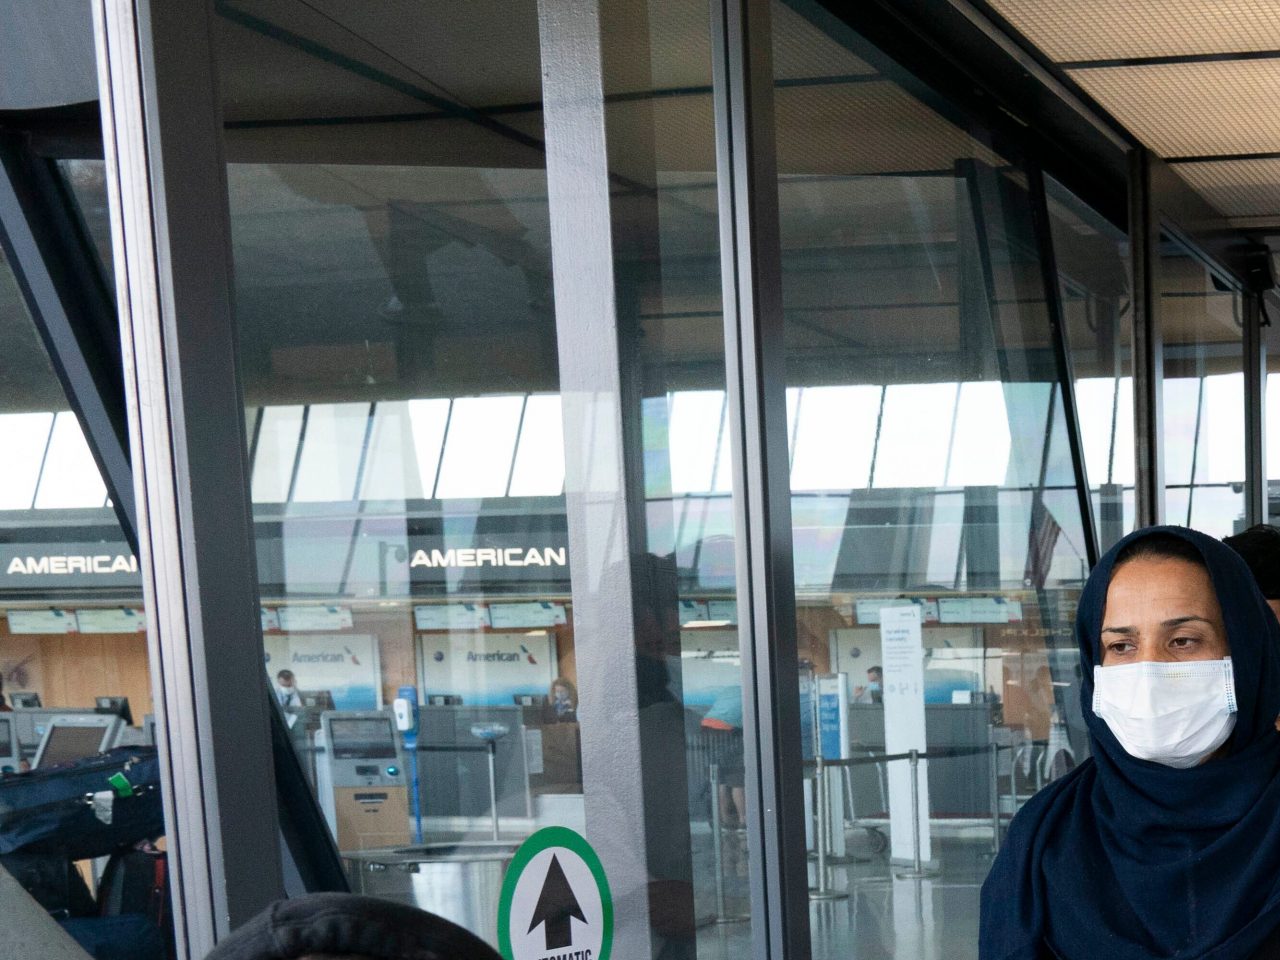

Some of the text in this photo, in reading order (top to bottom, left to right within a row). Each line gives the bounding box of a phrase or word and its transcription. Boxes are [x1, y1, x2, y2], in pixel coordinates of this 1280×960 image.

[410, 547, 566, 567] AMERICAN
[292, 651, 345, 663] American
[467, 650, 520, 662] American
